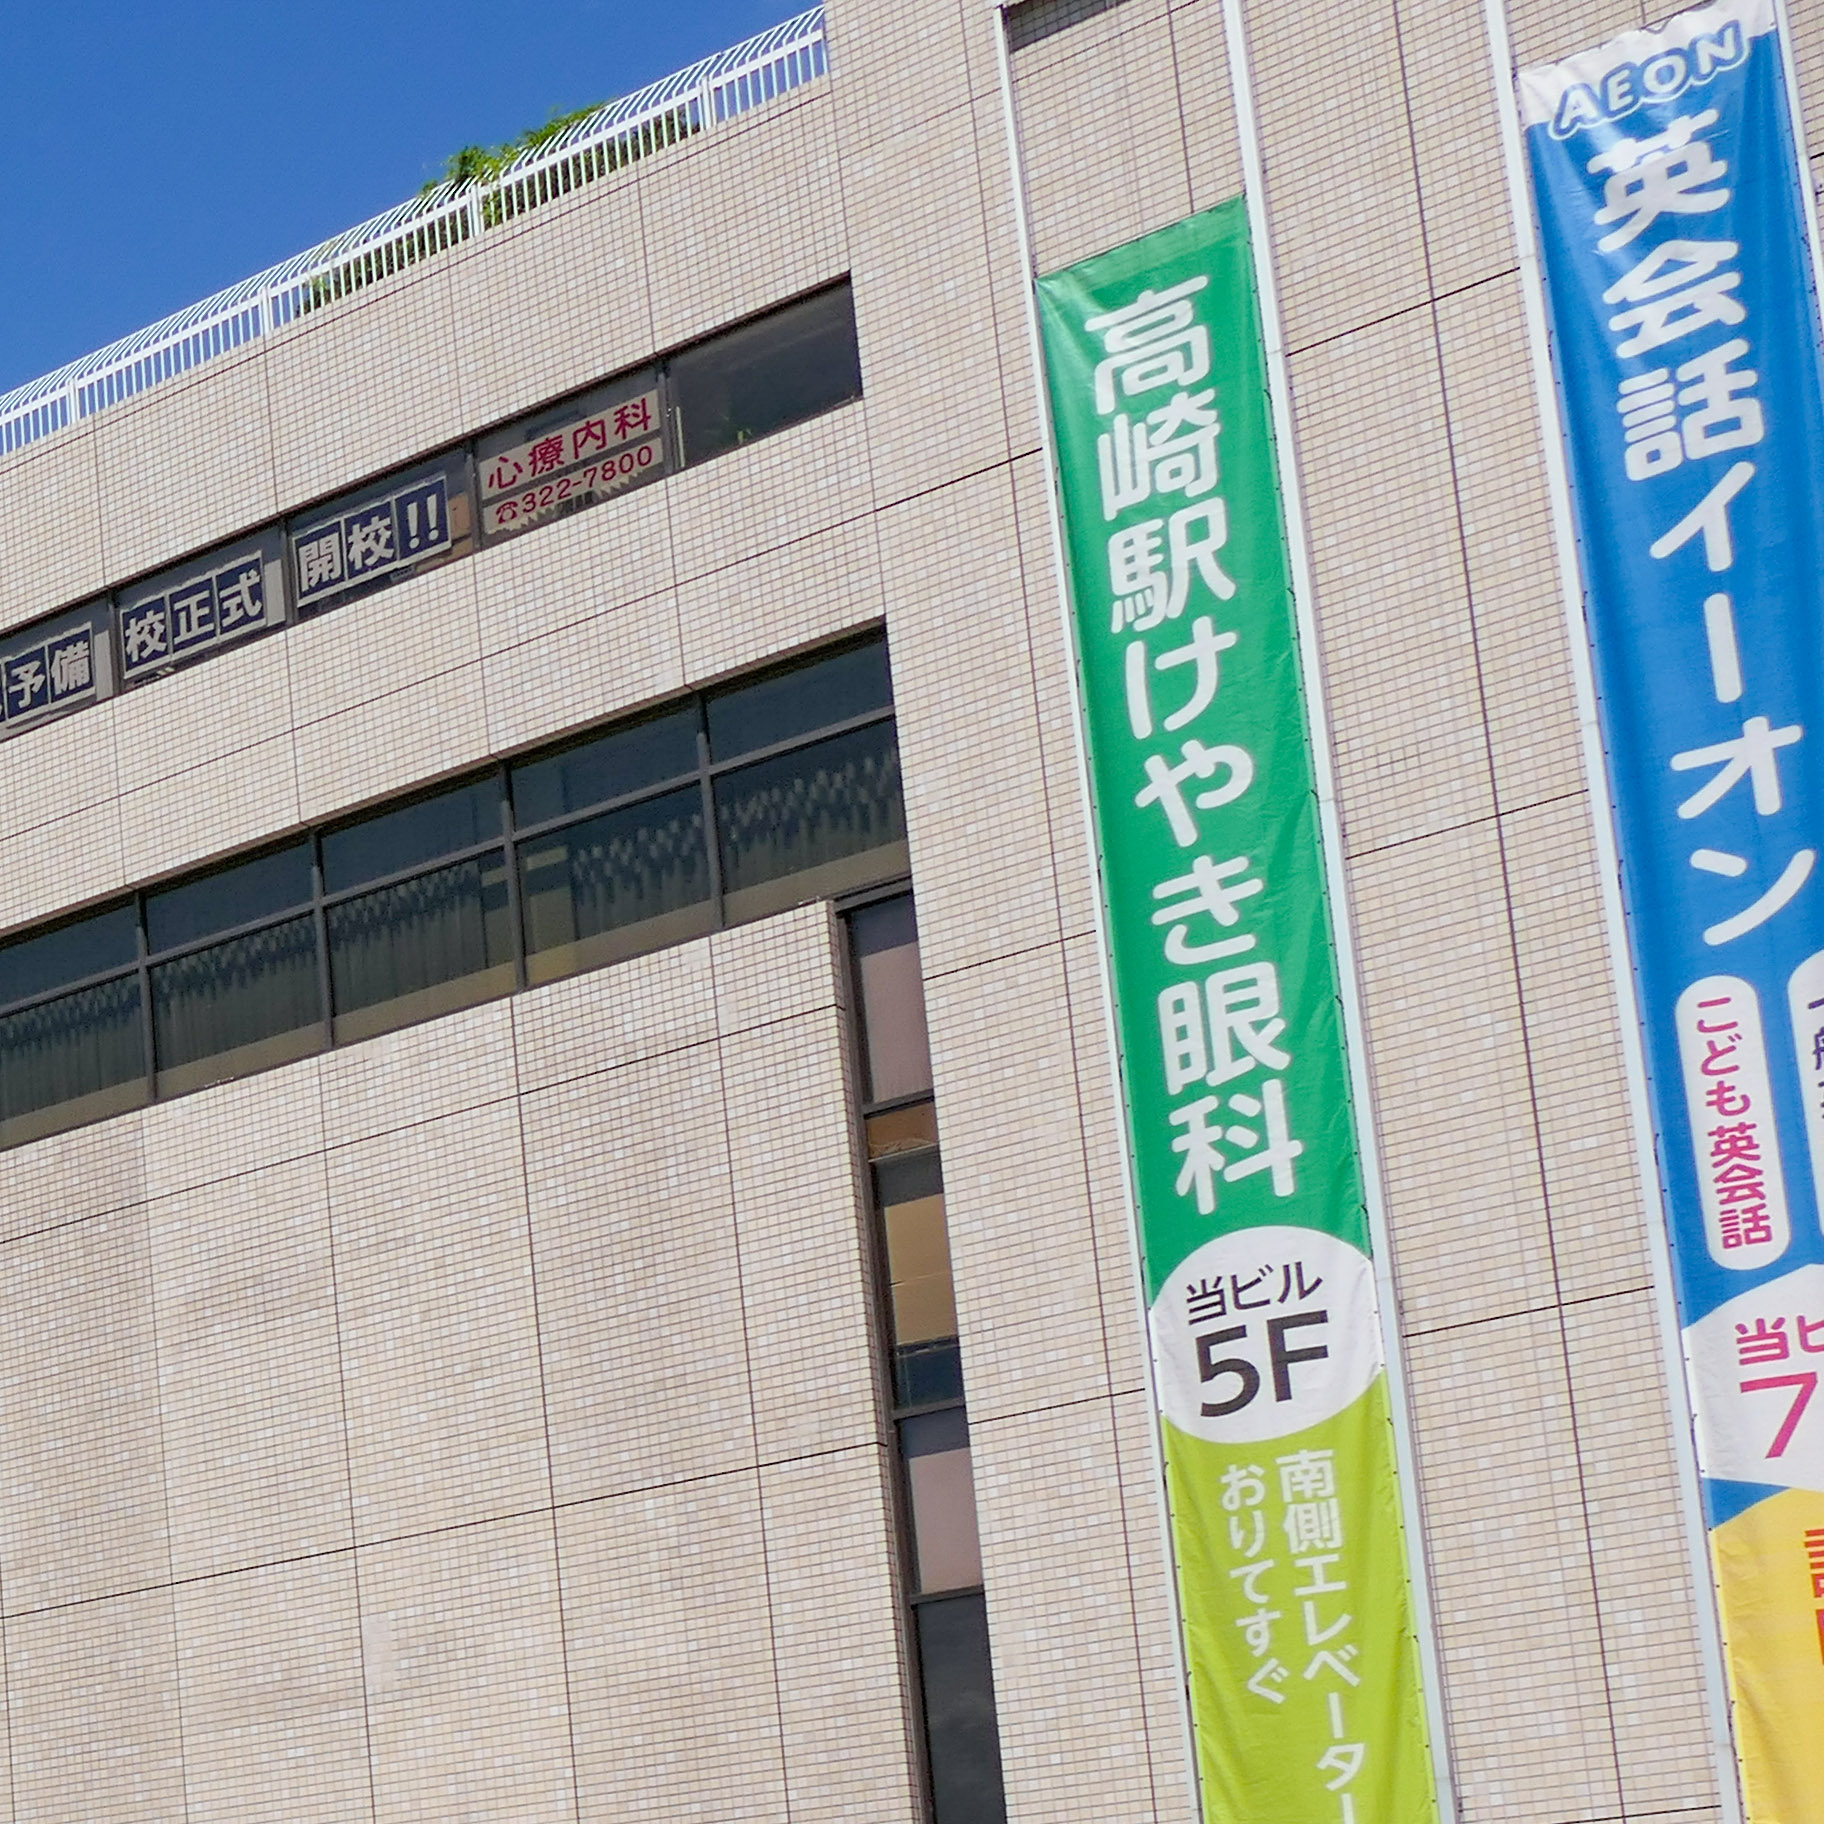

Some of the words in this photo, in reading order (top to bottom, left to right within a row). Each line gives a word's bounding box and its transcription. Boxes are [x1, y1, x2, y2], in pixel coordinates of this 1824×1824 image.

[1549, 21, 1752, 141] AEON
[488, 395, 653, 490] 心療内科
[1586, 107, 1815, 947] 英会話イーオン
[1083, 273, 1304, 1215] 高崎駅けやき眼科
[1696, 996, 1774, 1250] こども英会話
[1185, 1262, 1324, 1325] 当ビル
[1196, 1309, 1331, 1419] 5F
[1219, 1461, 1289, 1705] おりてすぐ
